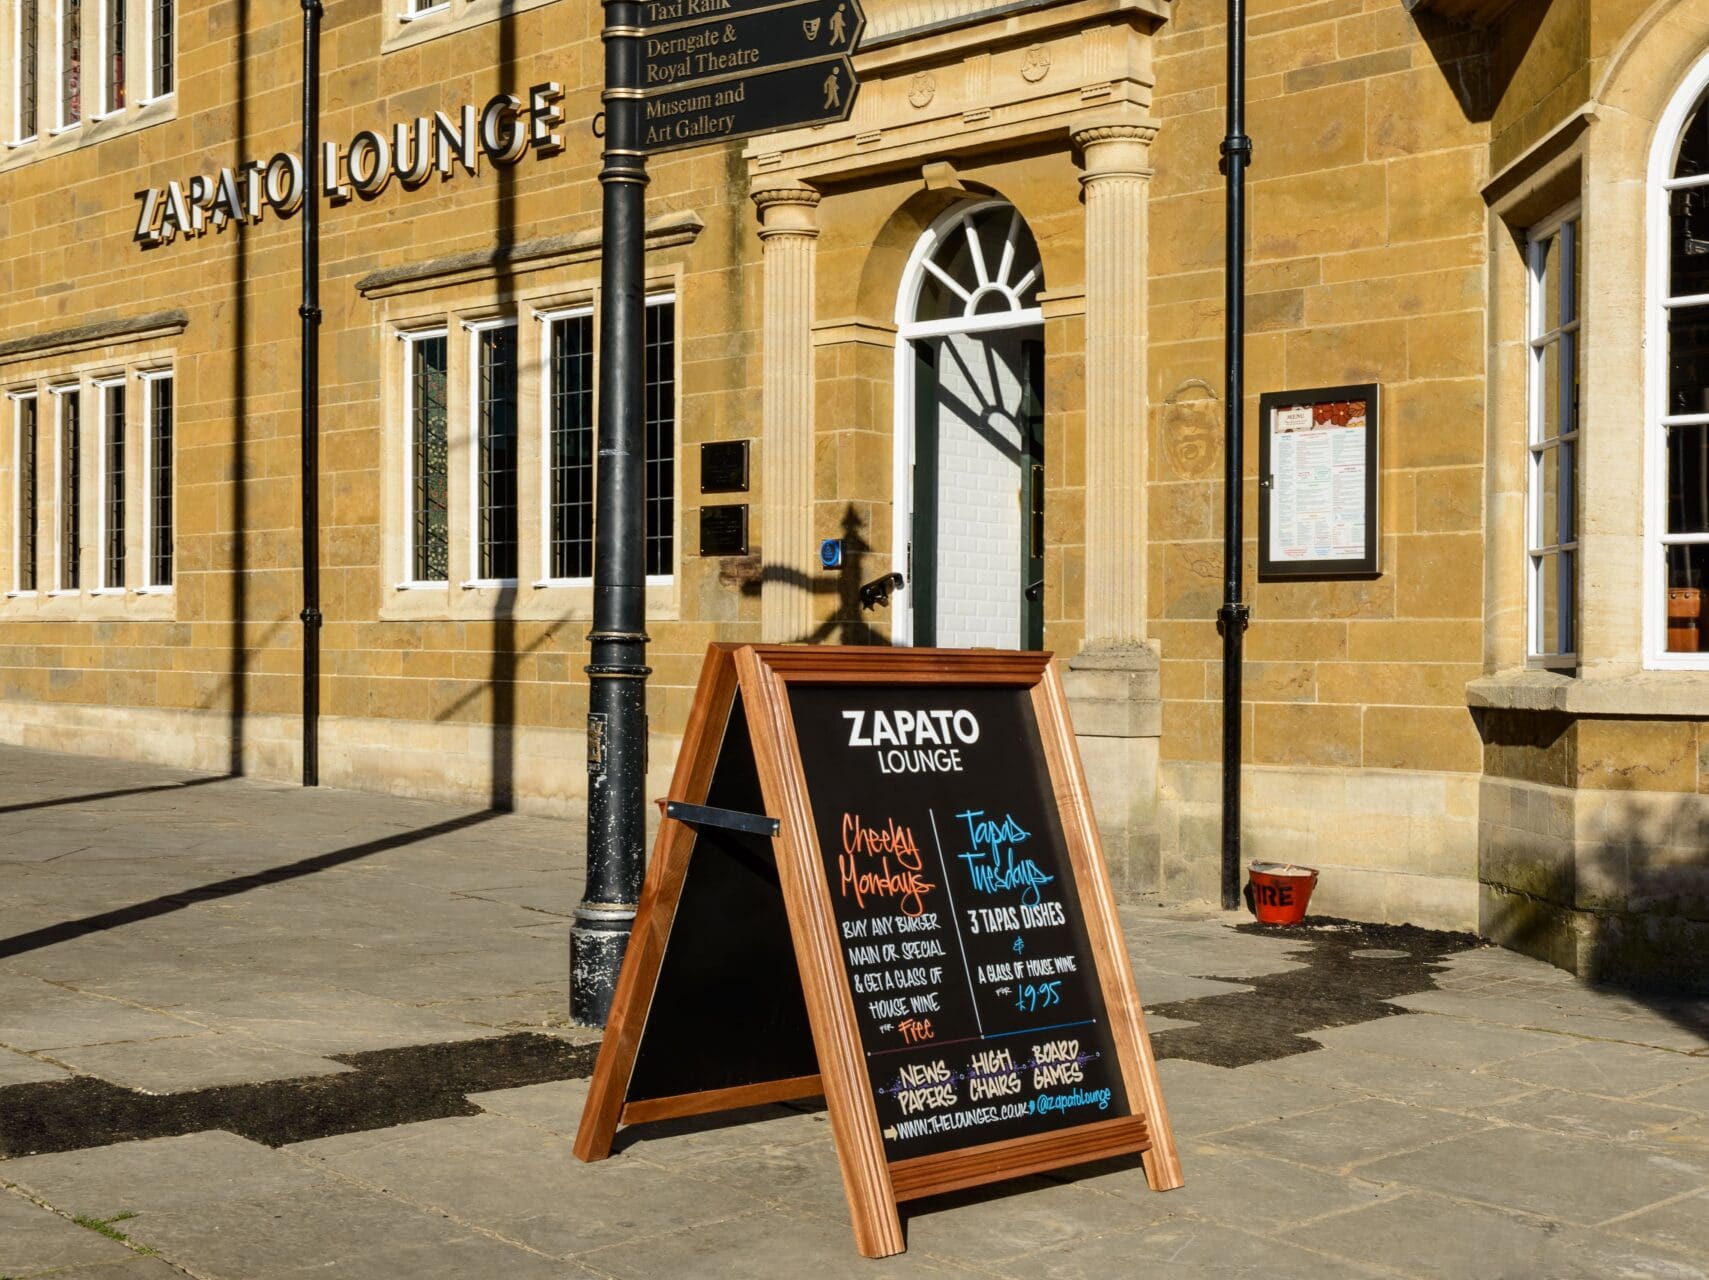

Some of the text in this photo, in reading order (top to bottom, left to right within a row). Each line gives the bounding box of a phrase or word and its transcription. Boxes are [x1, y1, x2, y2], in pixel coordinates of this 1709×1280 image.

[648, 0, 683, 22] Taxi
[647, 23, 737, 58] Derngate &
[647, 48, 760, 83] Royal Theatre
[646, 82, 745, 120] Museum and
[645, 114, 736, 145] Art Gallery
[133, 81, 567, 247] ZAPATO LOUNGE
[842, 708, 981, 748] ZAPATO
[877, 748, 964, 774] LOUNGE
[842, 812, 923, 871] Cheeky
[954, 809, 1032, 867] Tapas
[838, 853, 937, 918] Mondays
[957, 846, 1055, 907] Tuesdays
[842, 913, 942, 939] BUY ANY BURGER
[967, 901, 1066, 934] 3 TAPAS DISHES
[848, 939, 946, 966] MAIN OR SPECIAL
[853, 966, 943, 993] & GET A GLASS OF
[977, 955, 1078, 985] A GLASS OF HOUSE WINE
[868, 992, 941, 1020] HOUSE WINE
[897, 1018, 935, 1044] Free
[970, 1048, 1014, 1075] HIGH
[1031, 1039, 1080, 1065] BOARD
[899, 1060, 951, 1089] NEWS
[968, 1072, 1022, 1102] CHAIRS
[1033, 1062, 1084, 1090] GAMES
[897, 1085, 958, 1115] PAPERS
